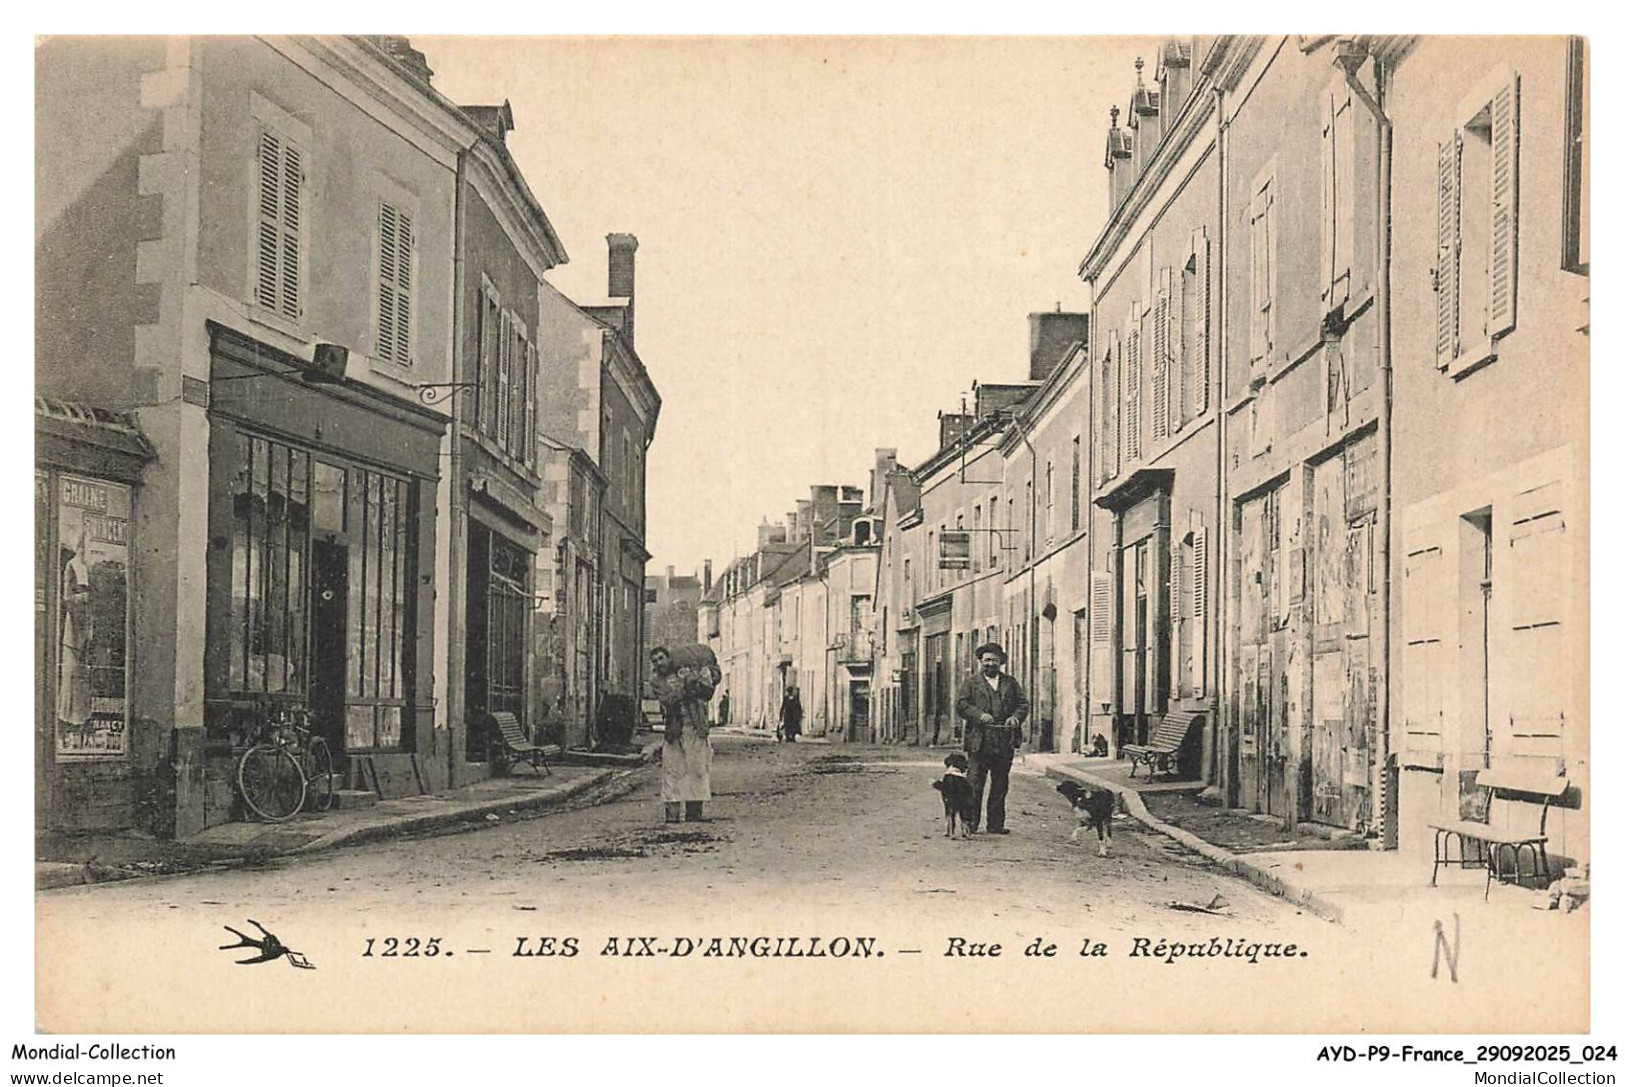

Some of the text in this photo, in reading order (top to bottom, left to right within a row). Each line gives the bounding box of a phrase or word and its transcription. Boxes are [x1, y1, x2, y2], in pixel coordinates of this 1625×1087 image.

[362, 937, 454, 957] 1225.
[512, 937, 579, 958] LES
[600, 937, 885, 958] AIX-D'ANGILLON.
[943, 937, 1002, 957] Rue
[1024, 937, 1058, 958] de
[1079, 938, 1108, 957] la
[1129, 936, 1308, 964] République.
[1431, 913, 1459, 984] N
